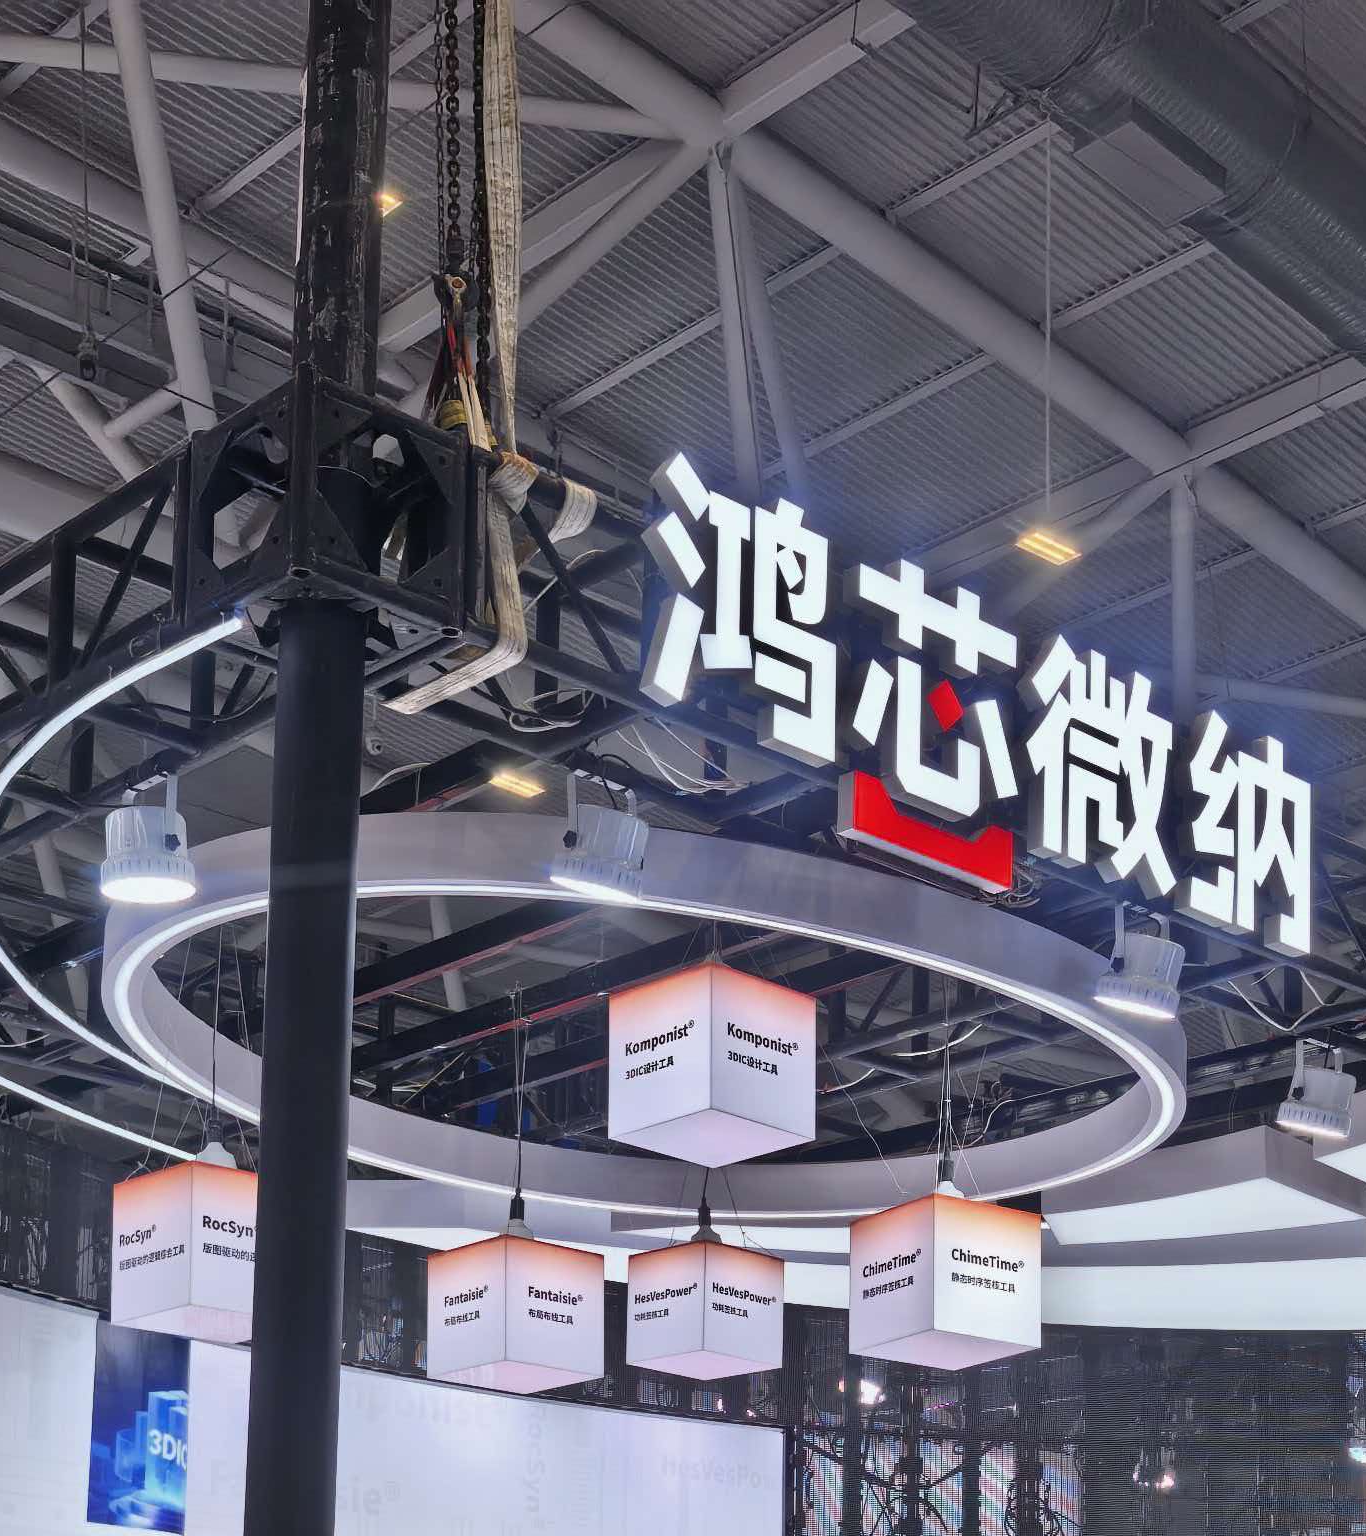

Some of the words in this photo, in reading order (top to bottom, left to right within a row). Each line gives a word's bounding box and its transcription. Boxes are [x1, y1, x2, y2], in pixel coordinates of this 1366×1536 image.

[641, 451, 1311, 955] 鸿芯微纳
[625, 1056, 674, 1080] 3DIC设计工具
[727, 1050, 778, 1076] 3DIC设计工具
[951, 1272, 1016, 1294] 静态时序签核工具
[444, 1309, 481, 1327] 布局布线工具
[528, 1308, 574, 1326] 布局布线工具
